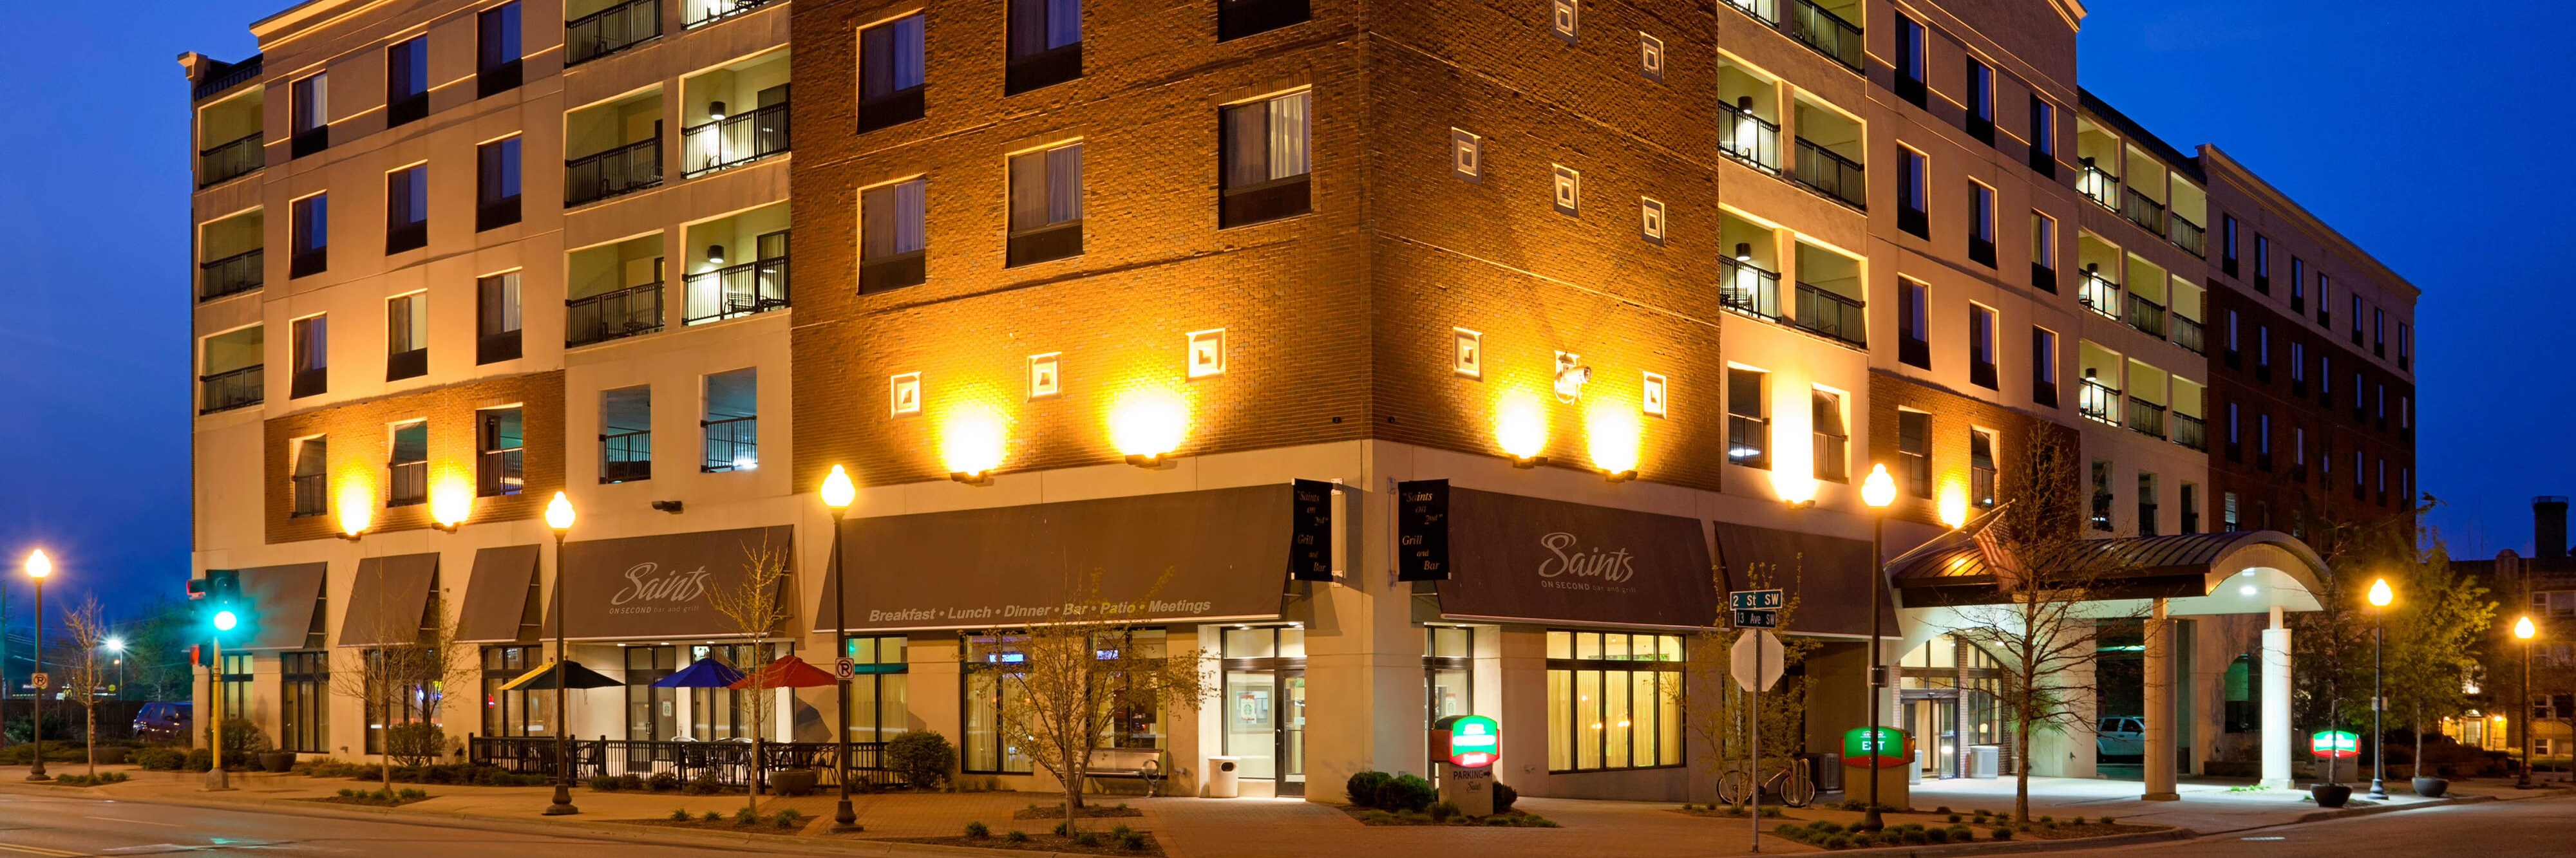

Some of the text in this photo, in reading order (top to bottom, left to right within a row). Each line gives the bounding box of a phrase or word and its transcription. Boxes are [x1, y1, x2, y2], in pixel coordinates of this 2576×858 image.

[1297, 534, 1313, 545] Grill
[1402, 535, 1423, 545] Grill
[1417, 548, 1429, 557] and
[1539, 532, 1634, 583] Saints
[1313, 561, 1326, 572] Bar
[1424, 560, 1440, 570] Bar
[611, 562, 711, 605] Saints
[1541, 580, 1554, 588] ON
[1555, 582, 1590, 590] SECOND
[1733, 593, 1779, 606] 2 St SW
[869, 599, 1211, 622] Breakfast Lunch Dinner Bar Patio Meetings
[1737, 612, 1775, 625] 13 Ave SW
[1862, 741, 1885, 751] ET
[1453, 770, 1483, 780] PARKING
